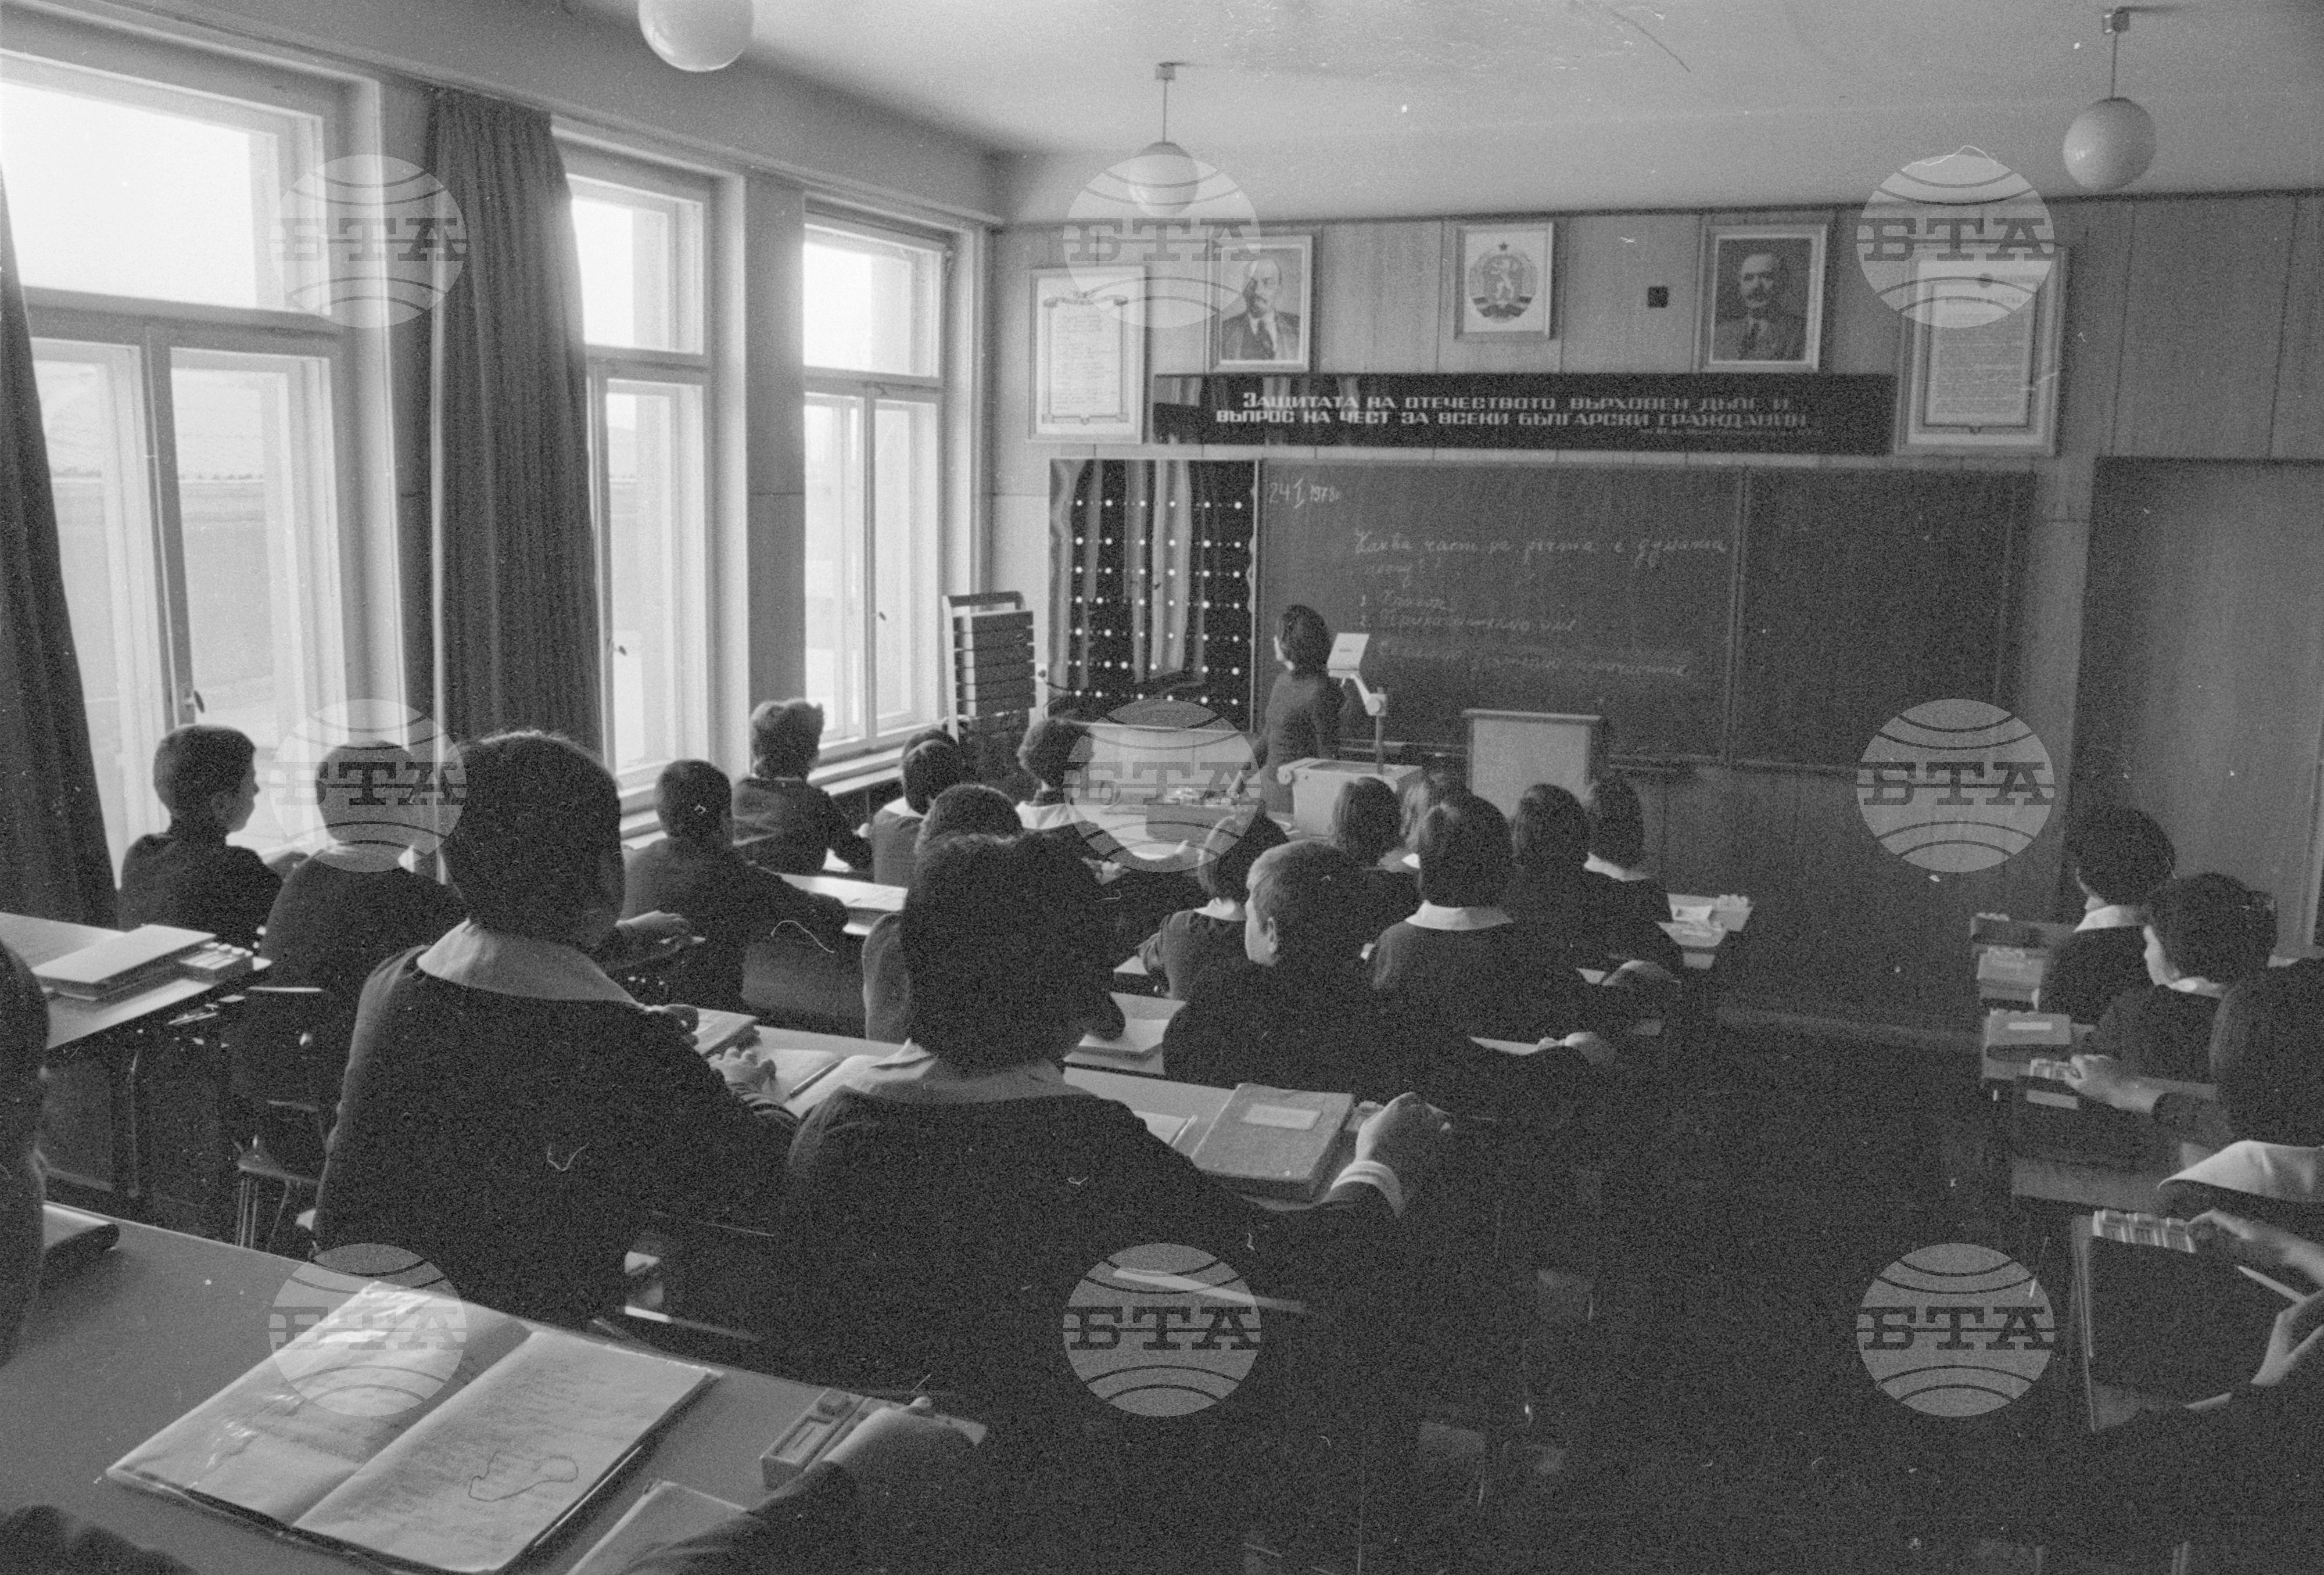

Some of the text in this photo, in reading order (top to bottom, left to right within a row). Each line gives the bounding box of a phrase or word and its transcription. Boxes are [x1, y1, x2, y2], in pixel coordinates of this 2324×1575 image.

[1367, 396, 1396, 408] НА
[1404, 396, 1556, 409] ОТЕЧЕСТВОТО
[1569, 397, 1688, 410] ВЪРХОВЕН
[1699, 397, 1755, 412] ДЪЛГ
[1773, 398, 1789, 410] И
[1216, 410, 1295, 423] ВЪПРОС
[1303, 410, 1330, 424] НА
[1339, 410, 1389, 424] ЧЕСТ
[1401, 411, 1429, 425] ЗА
[1437, 412, 1509, 425] ВСЕКИ
[1518, 412, 1649, 426] БЪЛГАРСКИ
